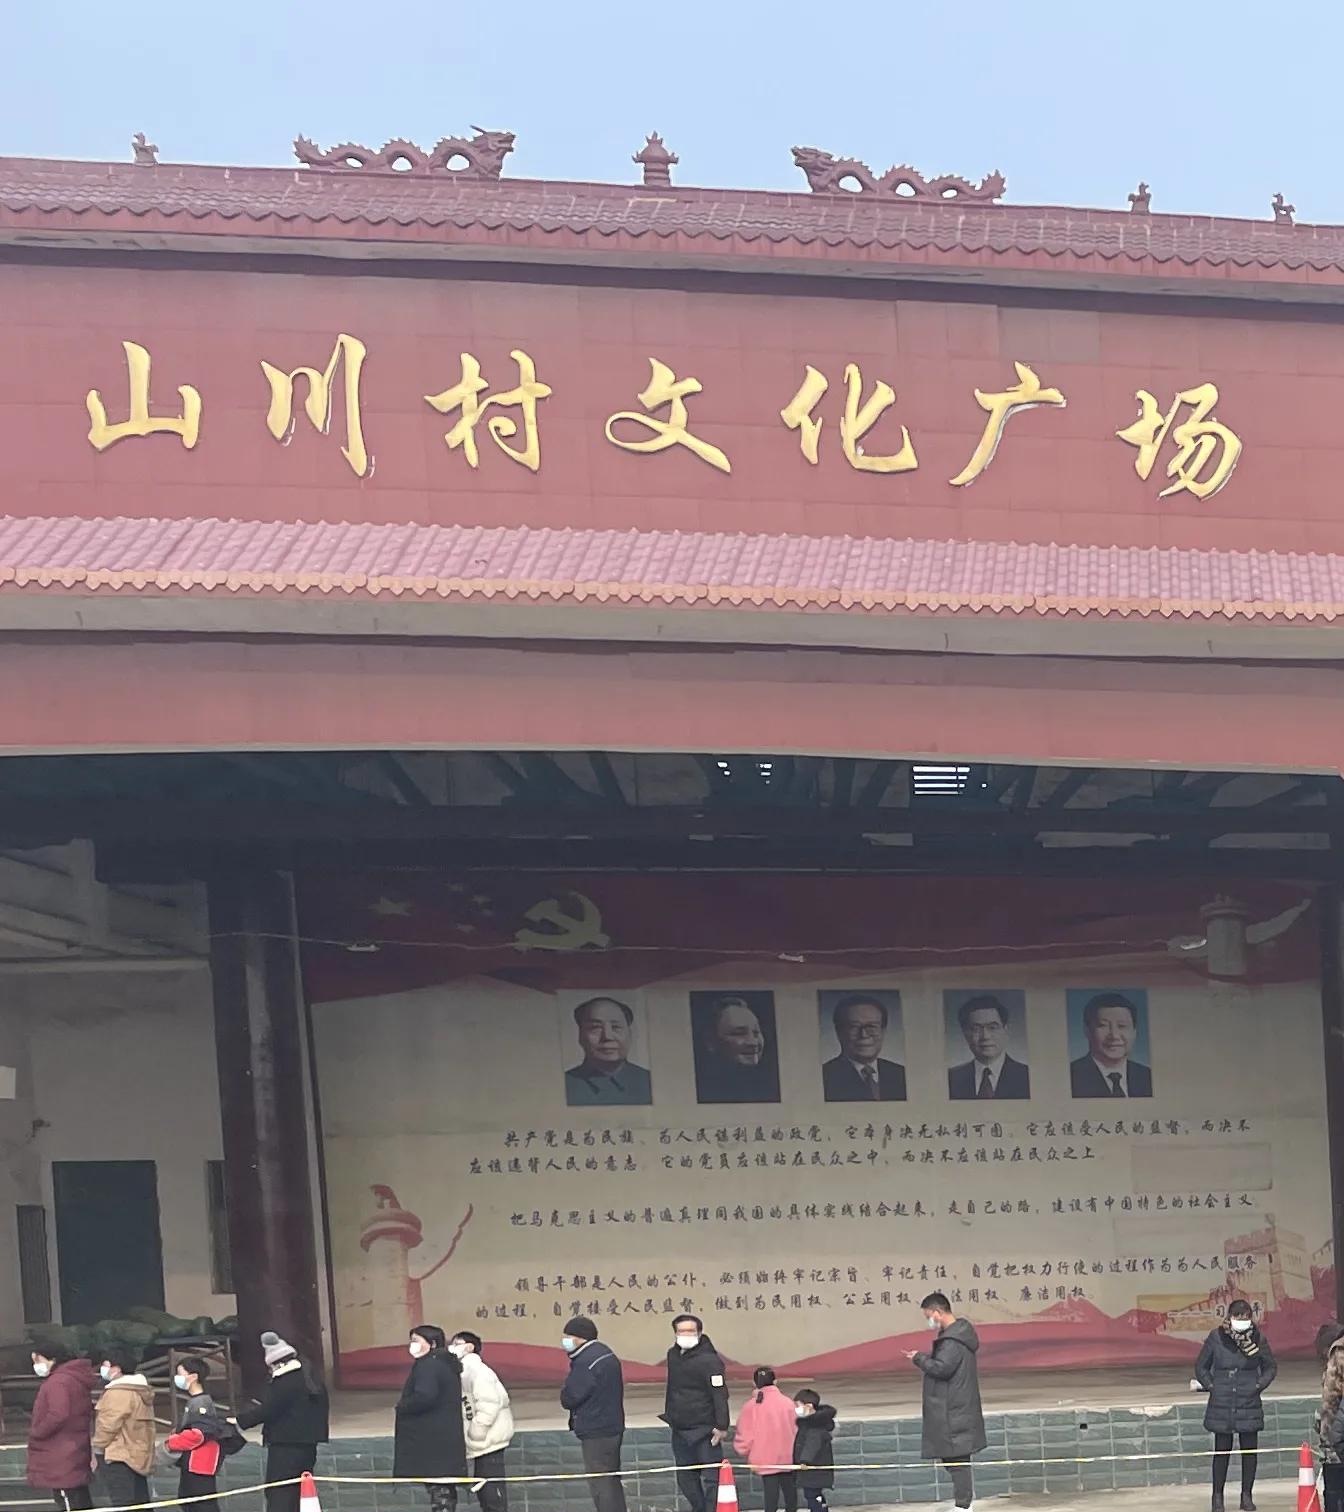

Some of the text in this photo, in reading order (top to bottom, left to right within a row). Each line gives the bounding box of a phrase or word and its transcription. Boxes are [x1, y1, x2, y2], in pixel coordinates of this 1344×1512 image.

[86, 333, 1243, 499] 山川村文化广场
